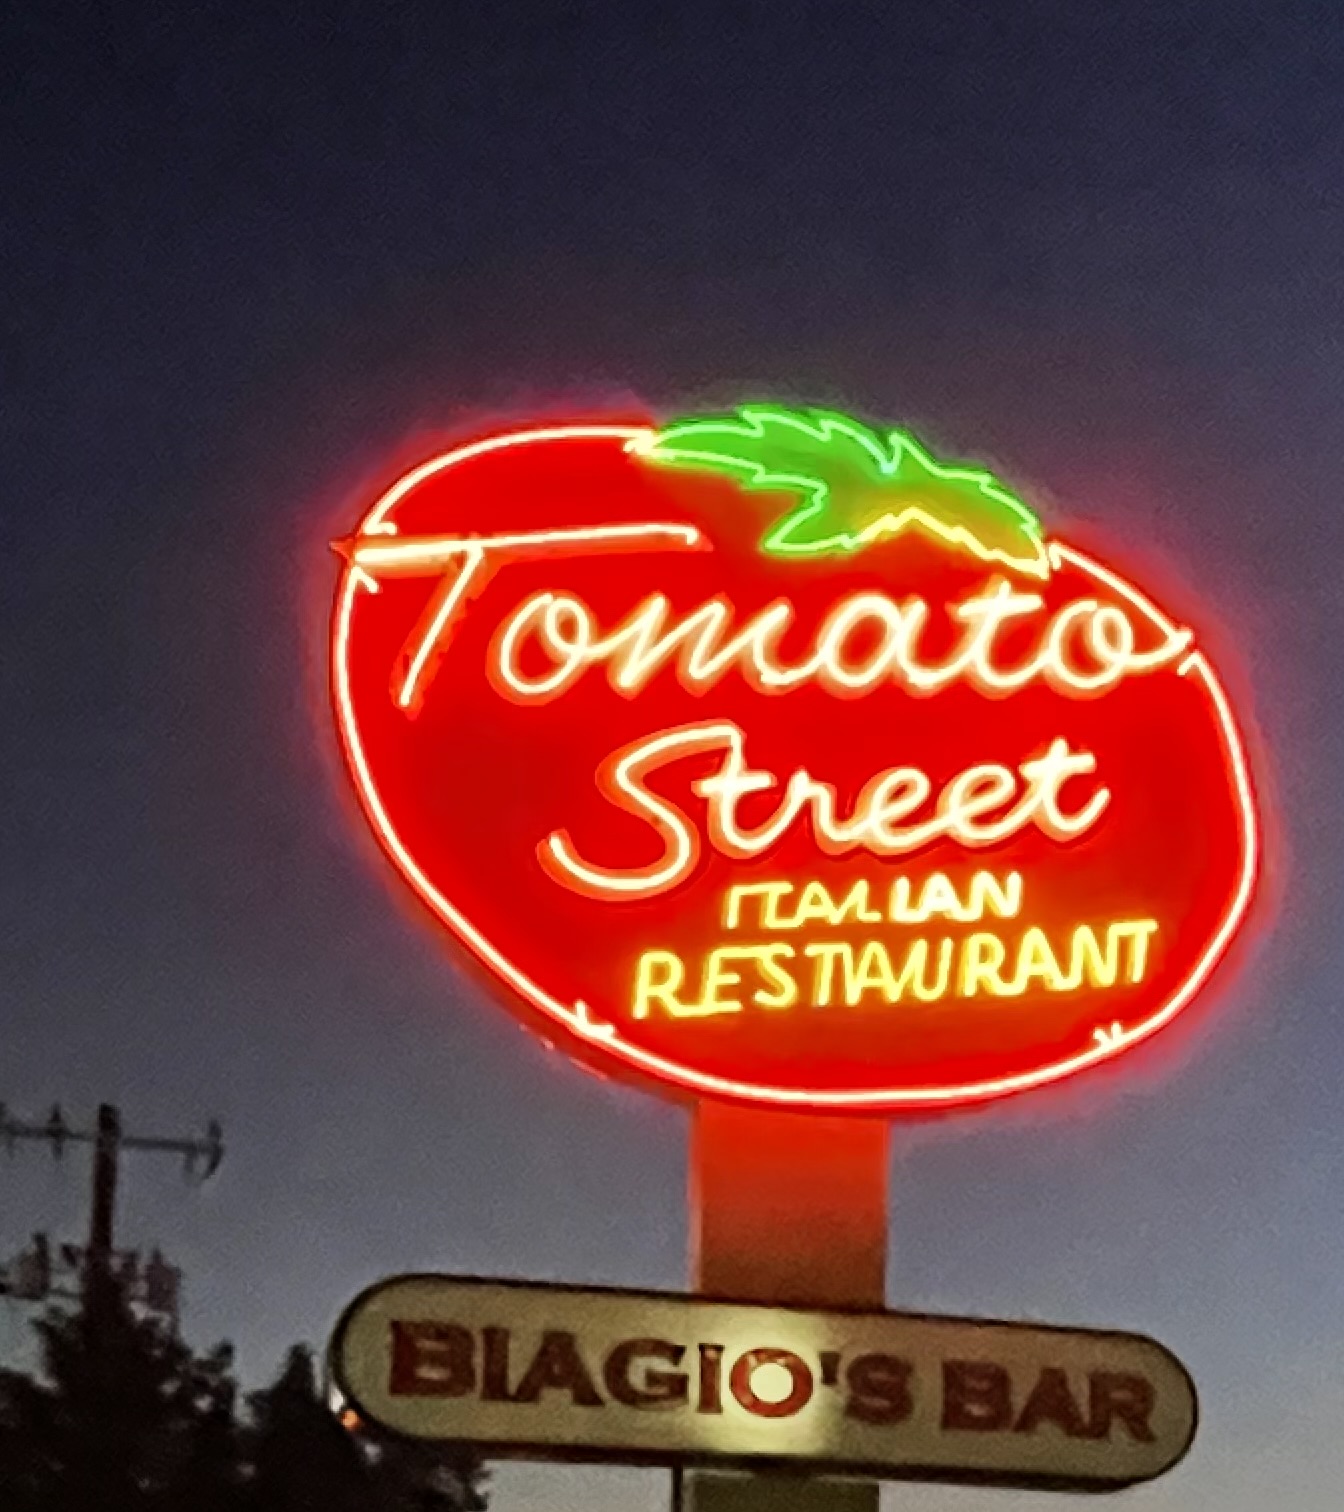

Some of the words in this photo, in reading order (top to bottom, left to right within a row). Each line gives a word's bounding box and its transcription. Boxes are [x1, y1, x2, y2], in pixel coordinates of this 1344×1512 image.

[350, 523, 1193, 708] Tomato
[544, 721, 1112, 892] Street
[725, 871, 1022, 929] ITALIAN
[632, 920, 1159, 1019] RESTAURANT
[387, 1320, 915, 1425] BIAGIO'S
[940, 1358, 1159, 1443] BAR
